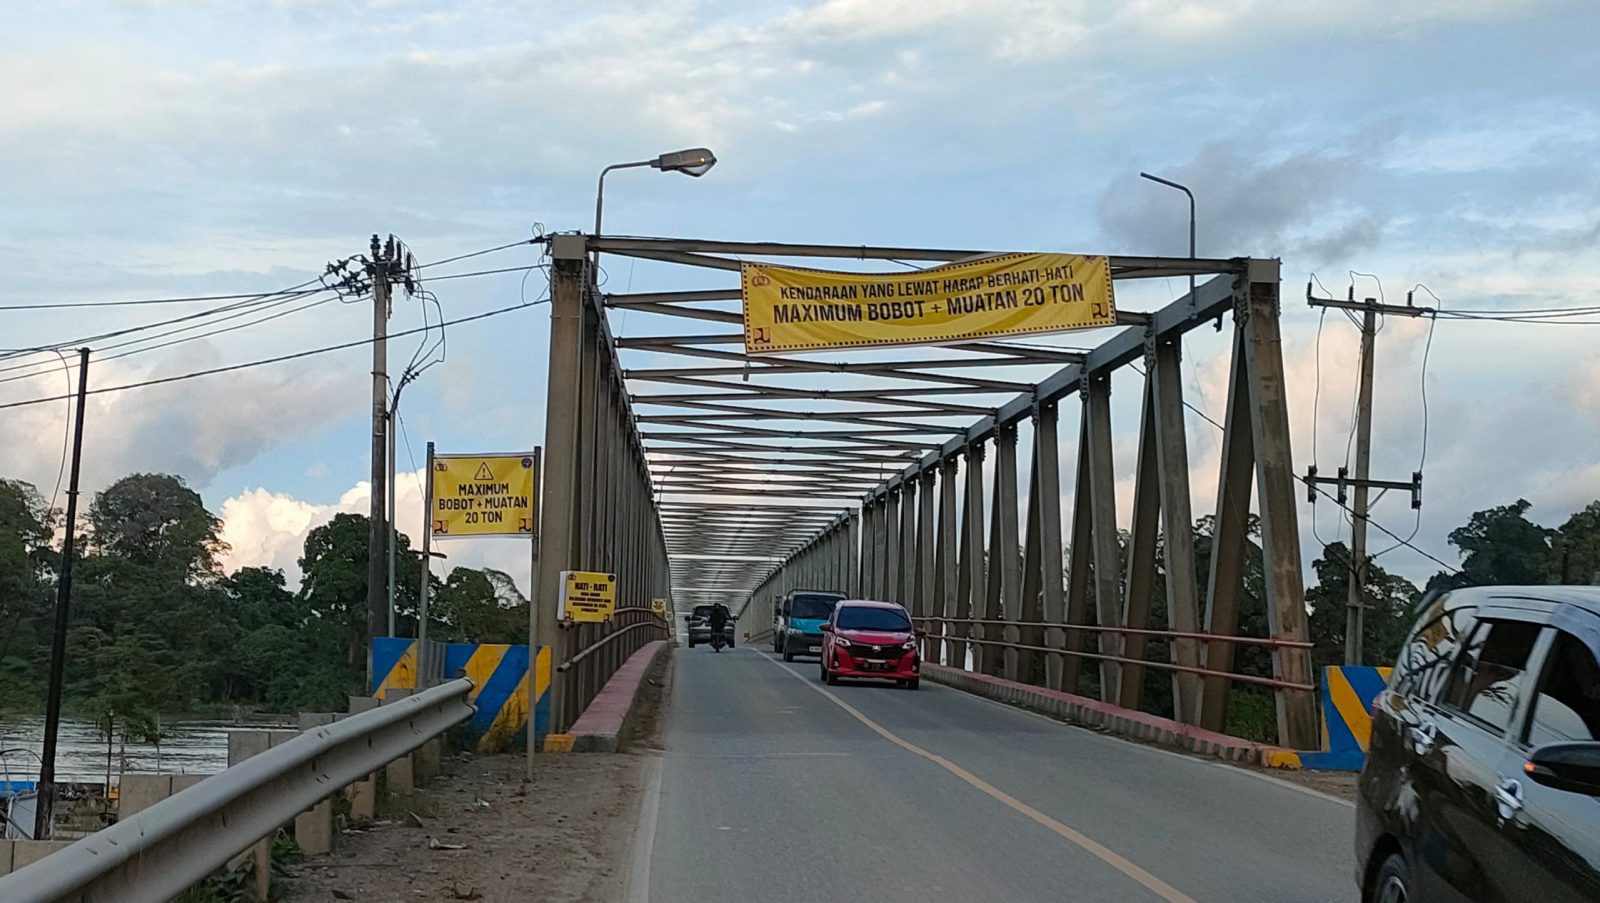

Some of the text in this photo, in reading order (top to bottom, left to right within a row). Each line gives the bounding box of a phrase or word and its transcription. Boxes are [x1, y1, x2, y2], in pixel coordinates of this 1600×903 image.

[780, 265, 1074, 300] KENDARAAN YANG LEWAT HARAP BERHATI-HATI
[773, 283, 1085, 324] MAXIMUM BOBOT + MUATAN 20 TON
[458, 483, 509, 496] MAXIMUM
[439, 498, 473, 510] BOBOT
[484, 496, 528, 509] MUATAN
[465, 511, 503, 524] 20 TON
